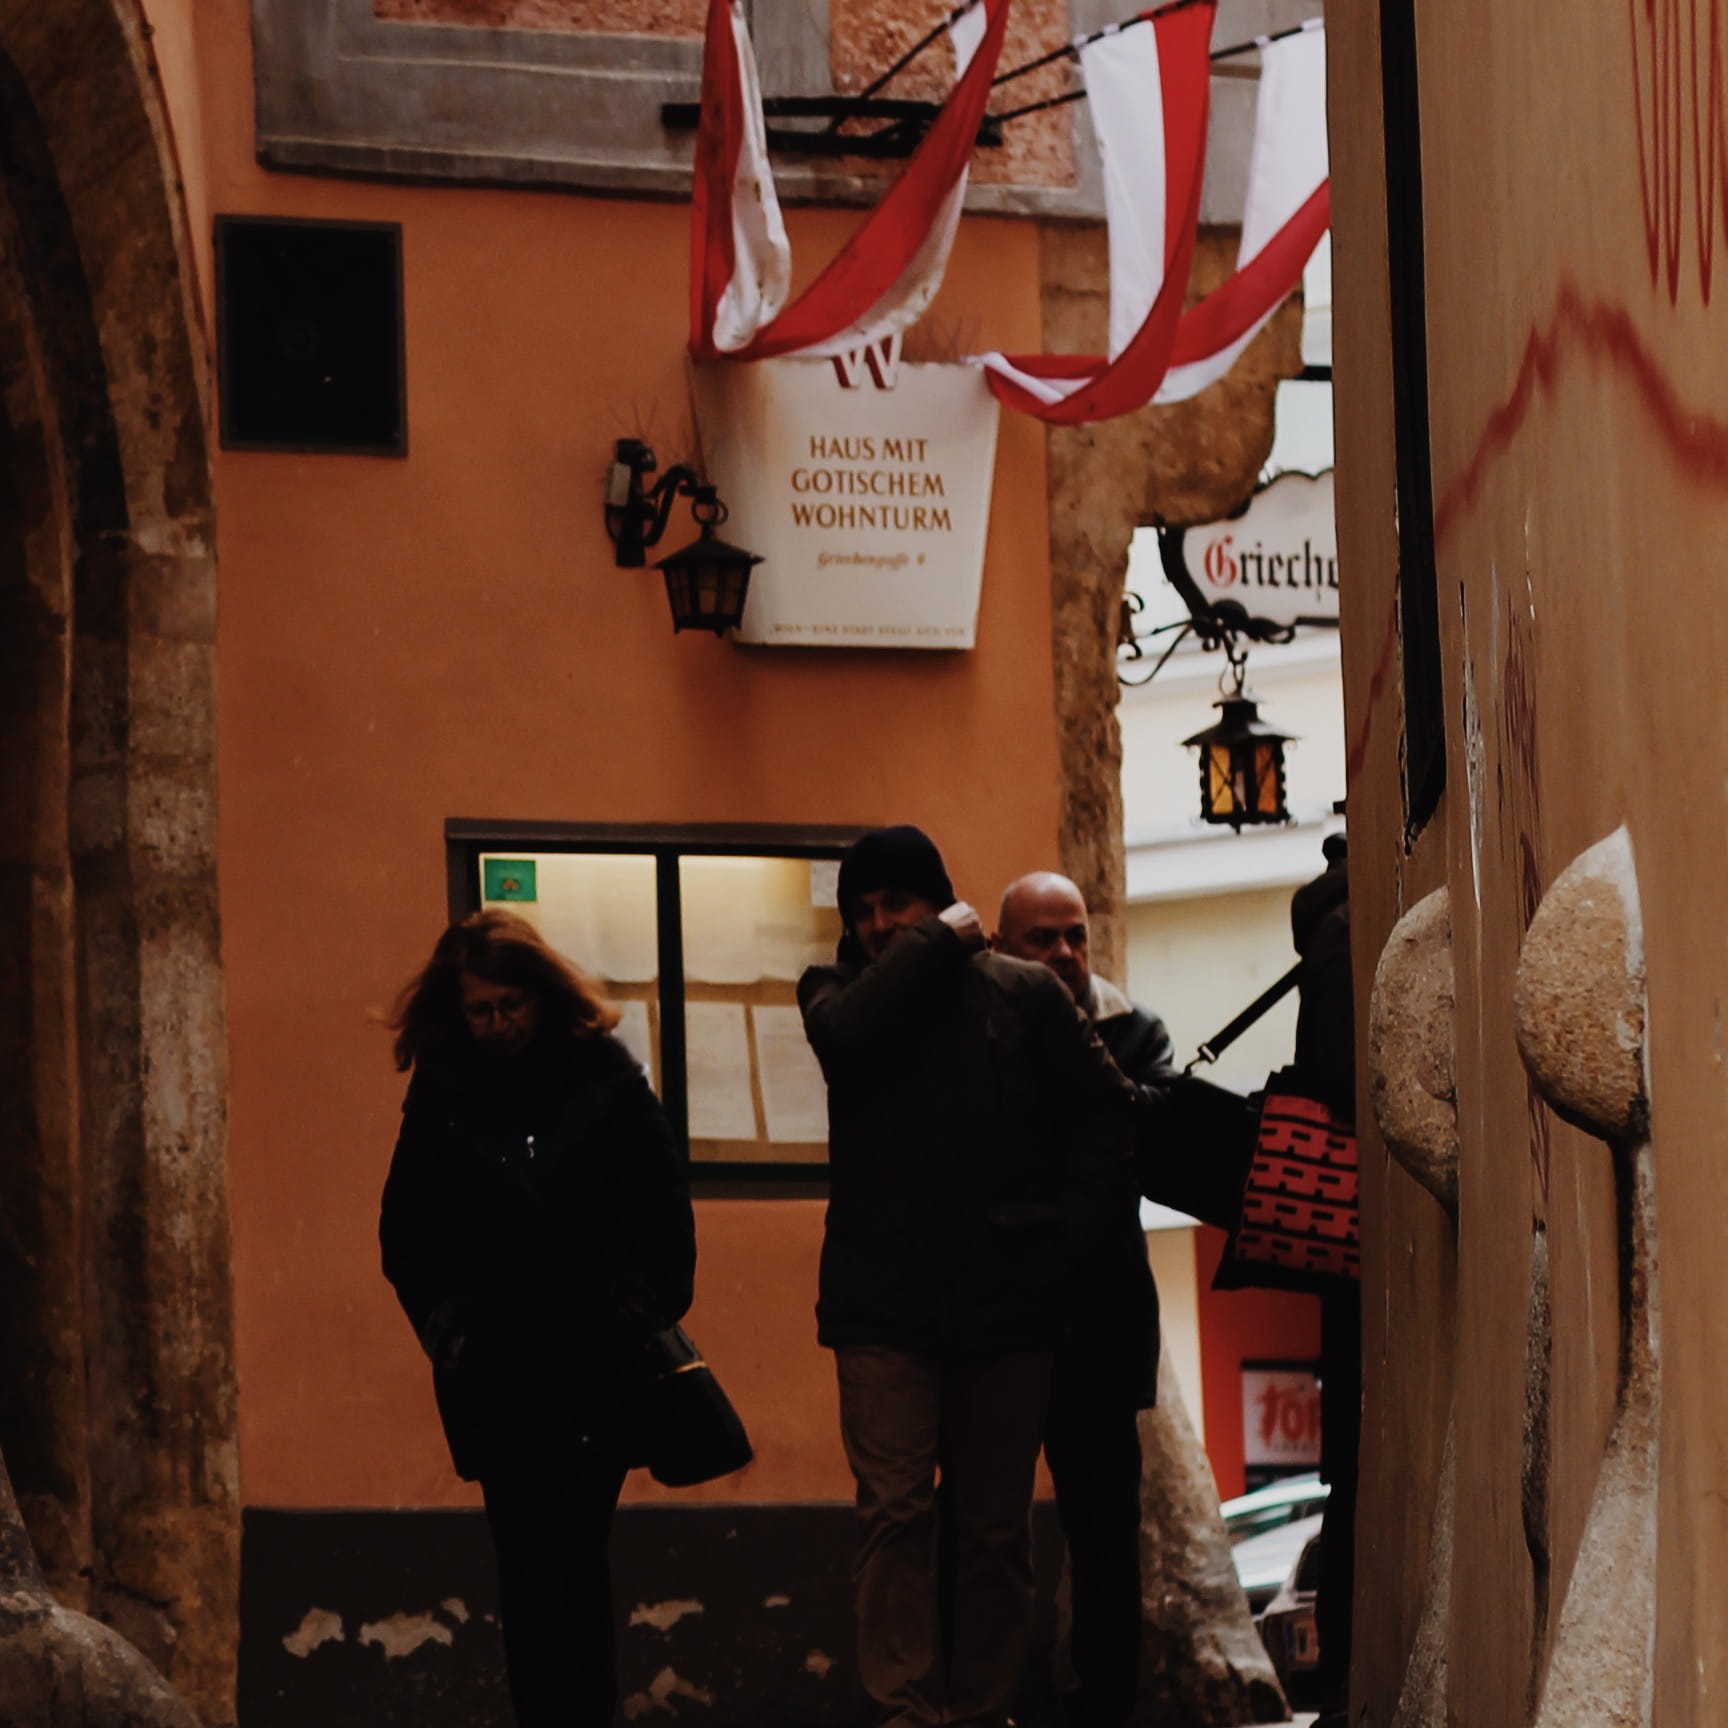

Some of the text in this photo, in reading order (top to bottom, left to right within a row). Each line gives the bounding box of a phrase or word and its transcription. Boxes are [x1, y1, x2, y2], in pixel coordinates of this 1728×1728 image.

[809, 434, 929, 463] HAUS MIT
[791, 467, 945, 497] GOTISCHEM
[791, 502, 952, 532] WOHNTURM
